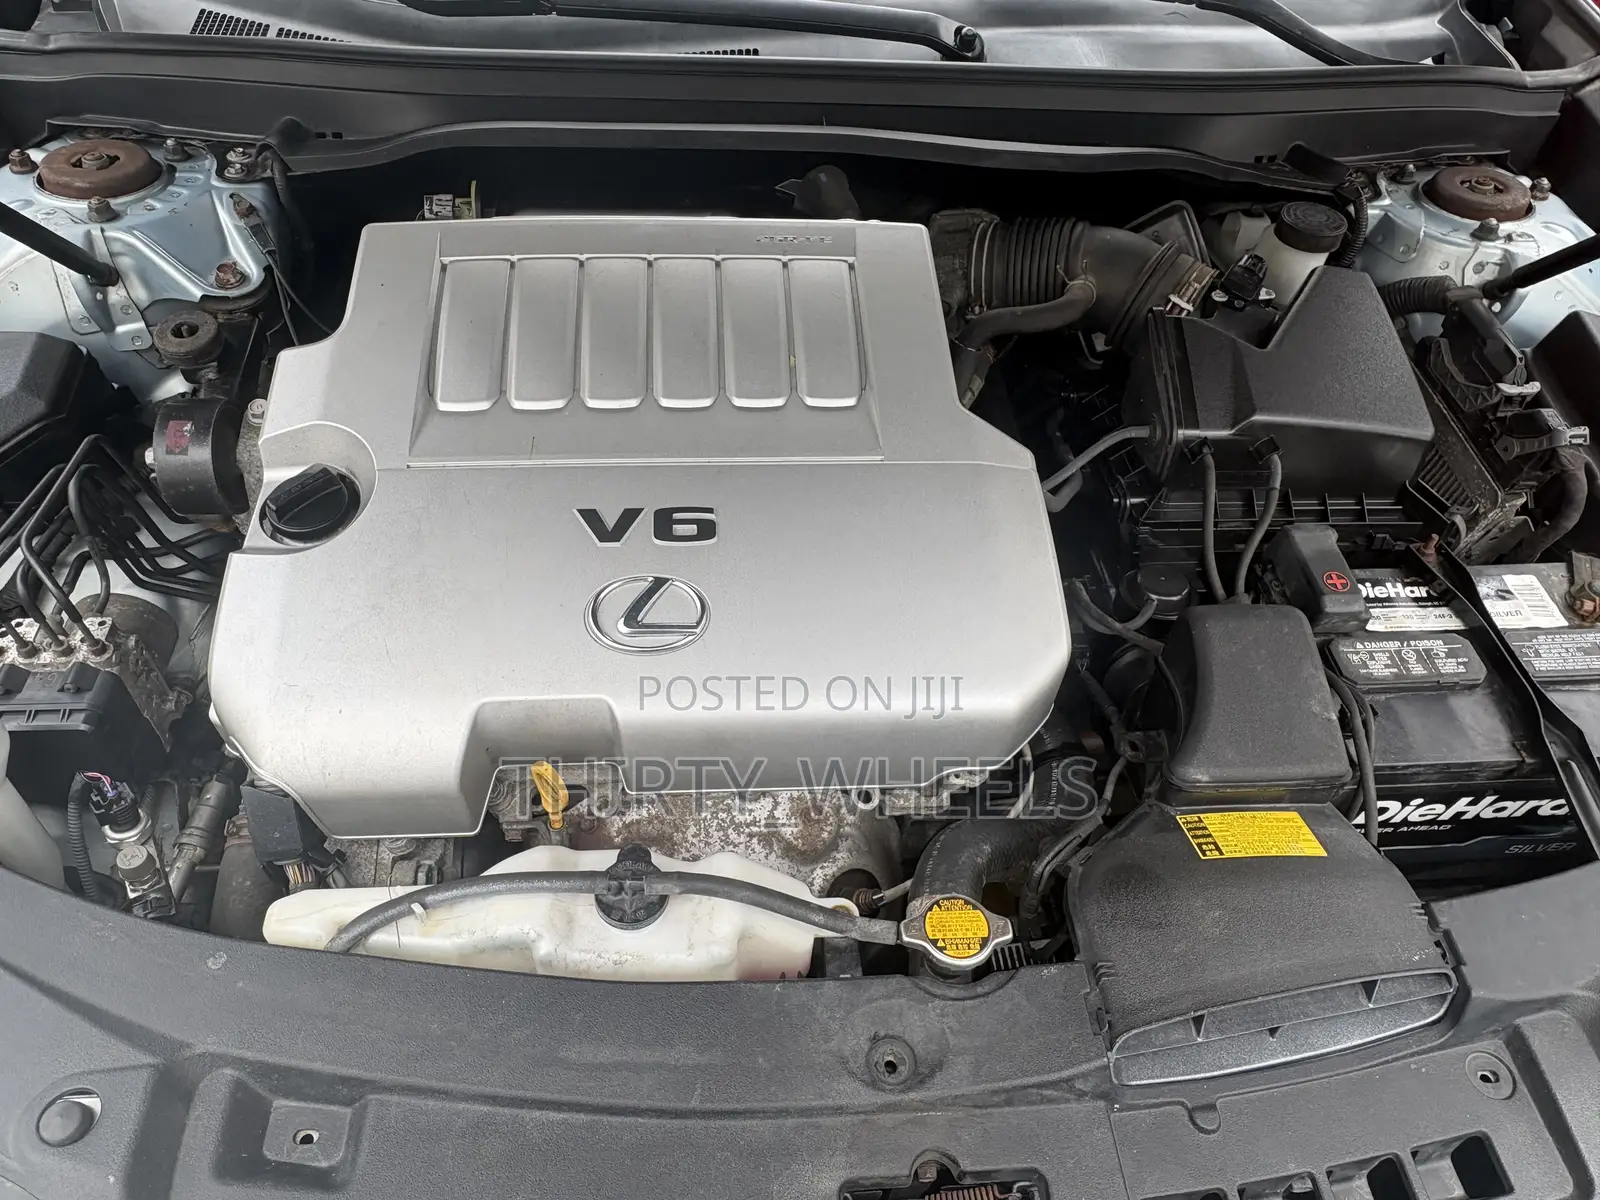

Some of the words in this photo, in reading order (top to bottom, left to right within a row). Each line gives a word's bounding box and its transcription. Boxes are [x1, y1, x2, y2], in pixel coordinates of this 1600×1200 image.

[572, 506, 718, 547] V6
[1364, 640, 1401, 649] DANGER
[1409, 639, 1444, 647] POISON
[1397, 824, 1453, 832] AHEAD
[1505, 842, 1577, 854] SILVER
